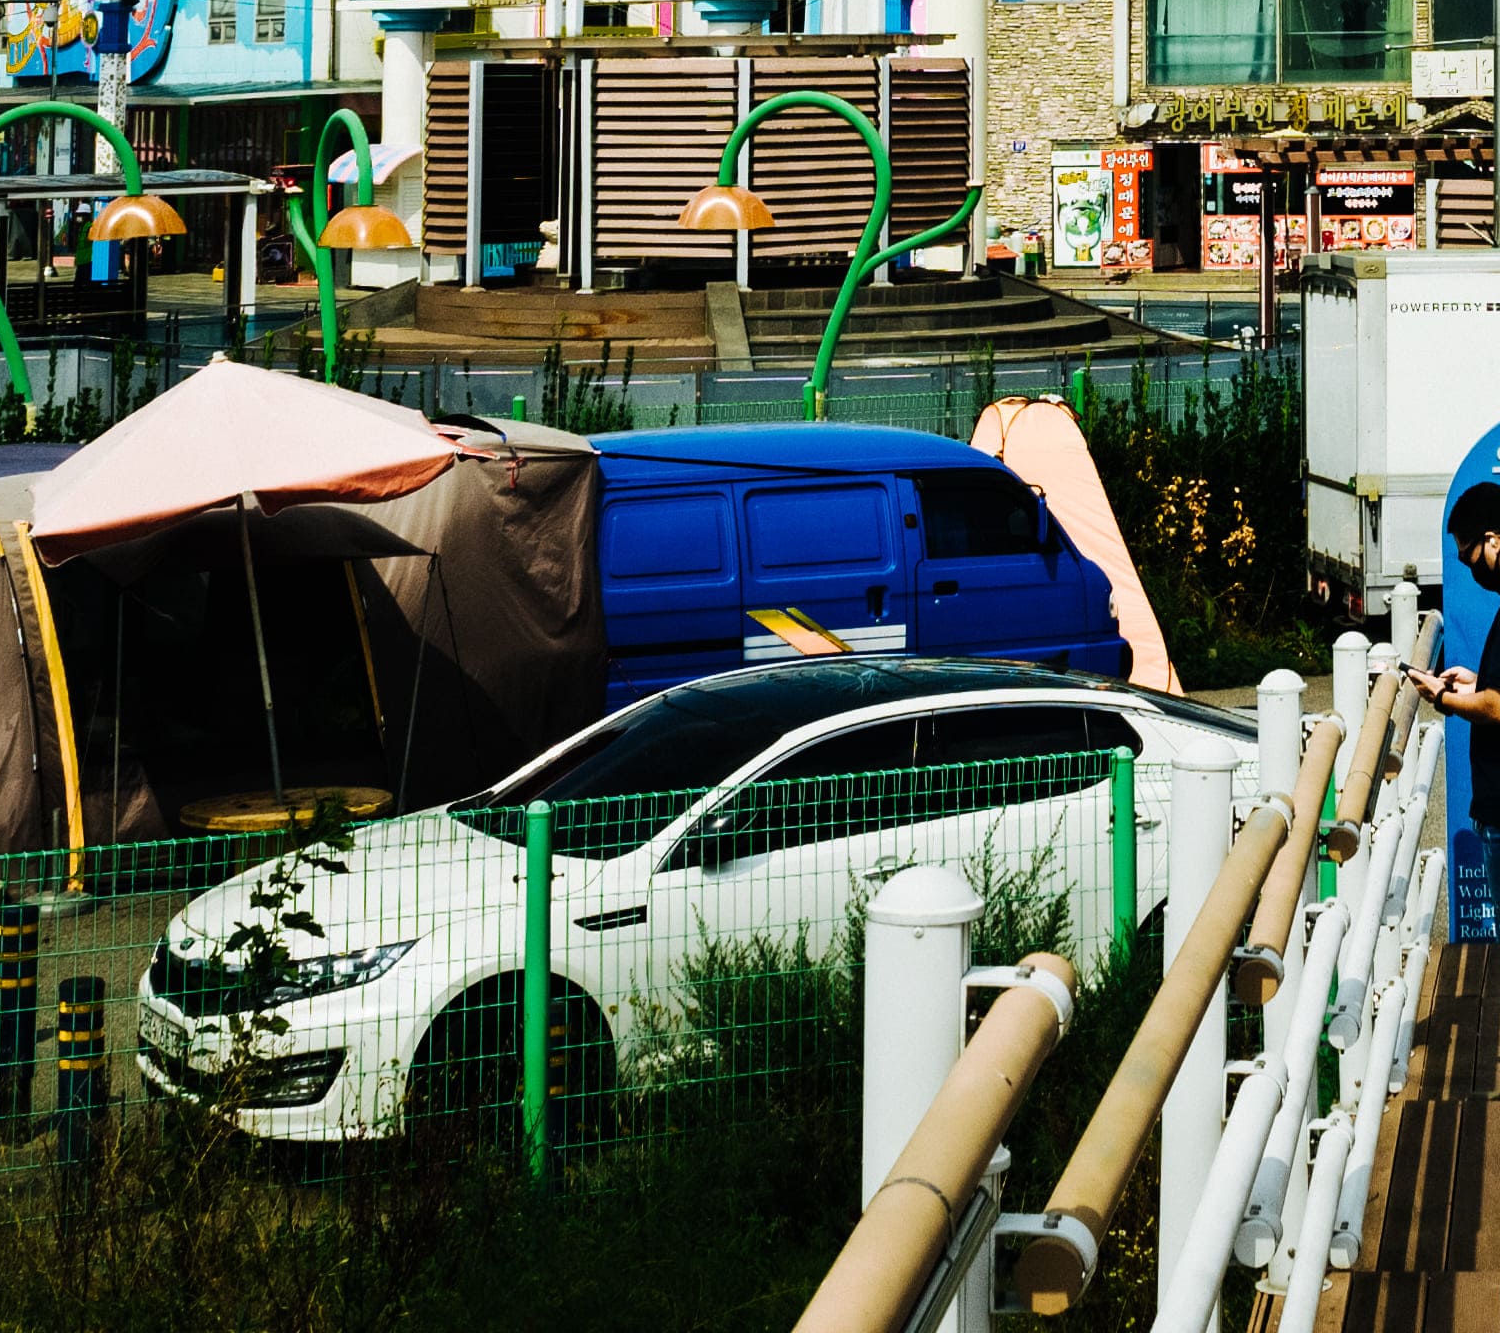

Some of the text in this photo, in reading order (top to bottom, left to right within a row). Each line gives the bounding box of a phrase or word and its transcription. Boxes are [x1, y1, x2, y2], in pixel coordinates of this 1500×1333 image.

[1164, 94, 1276, 133] 광어부인
[1322, 93, 1409, 131] 때문에
[1390, 302, 1459, 314] POWERED
[1460, 922, 1497, 939] Road
